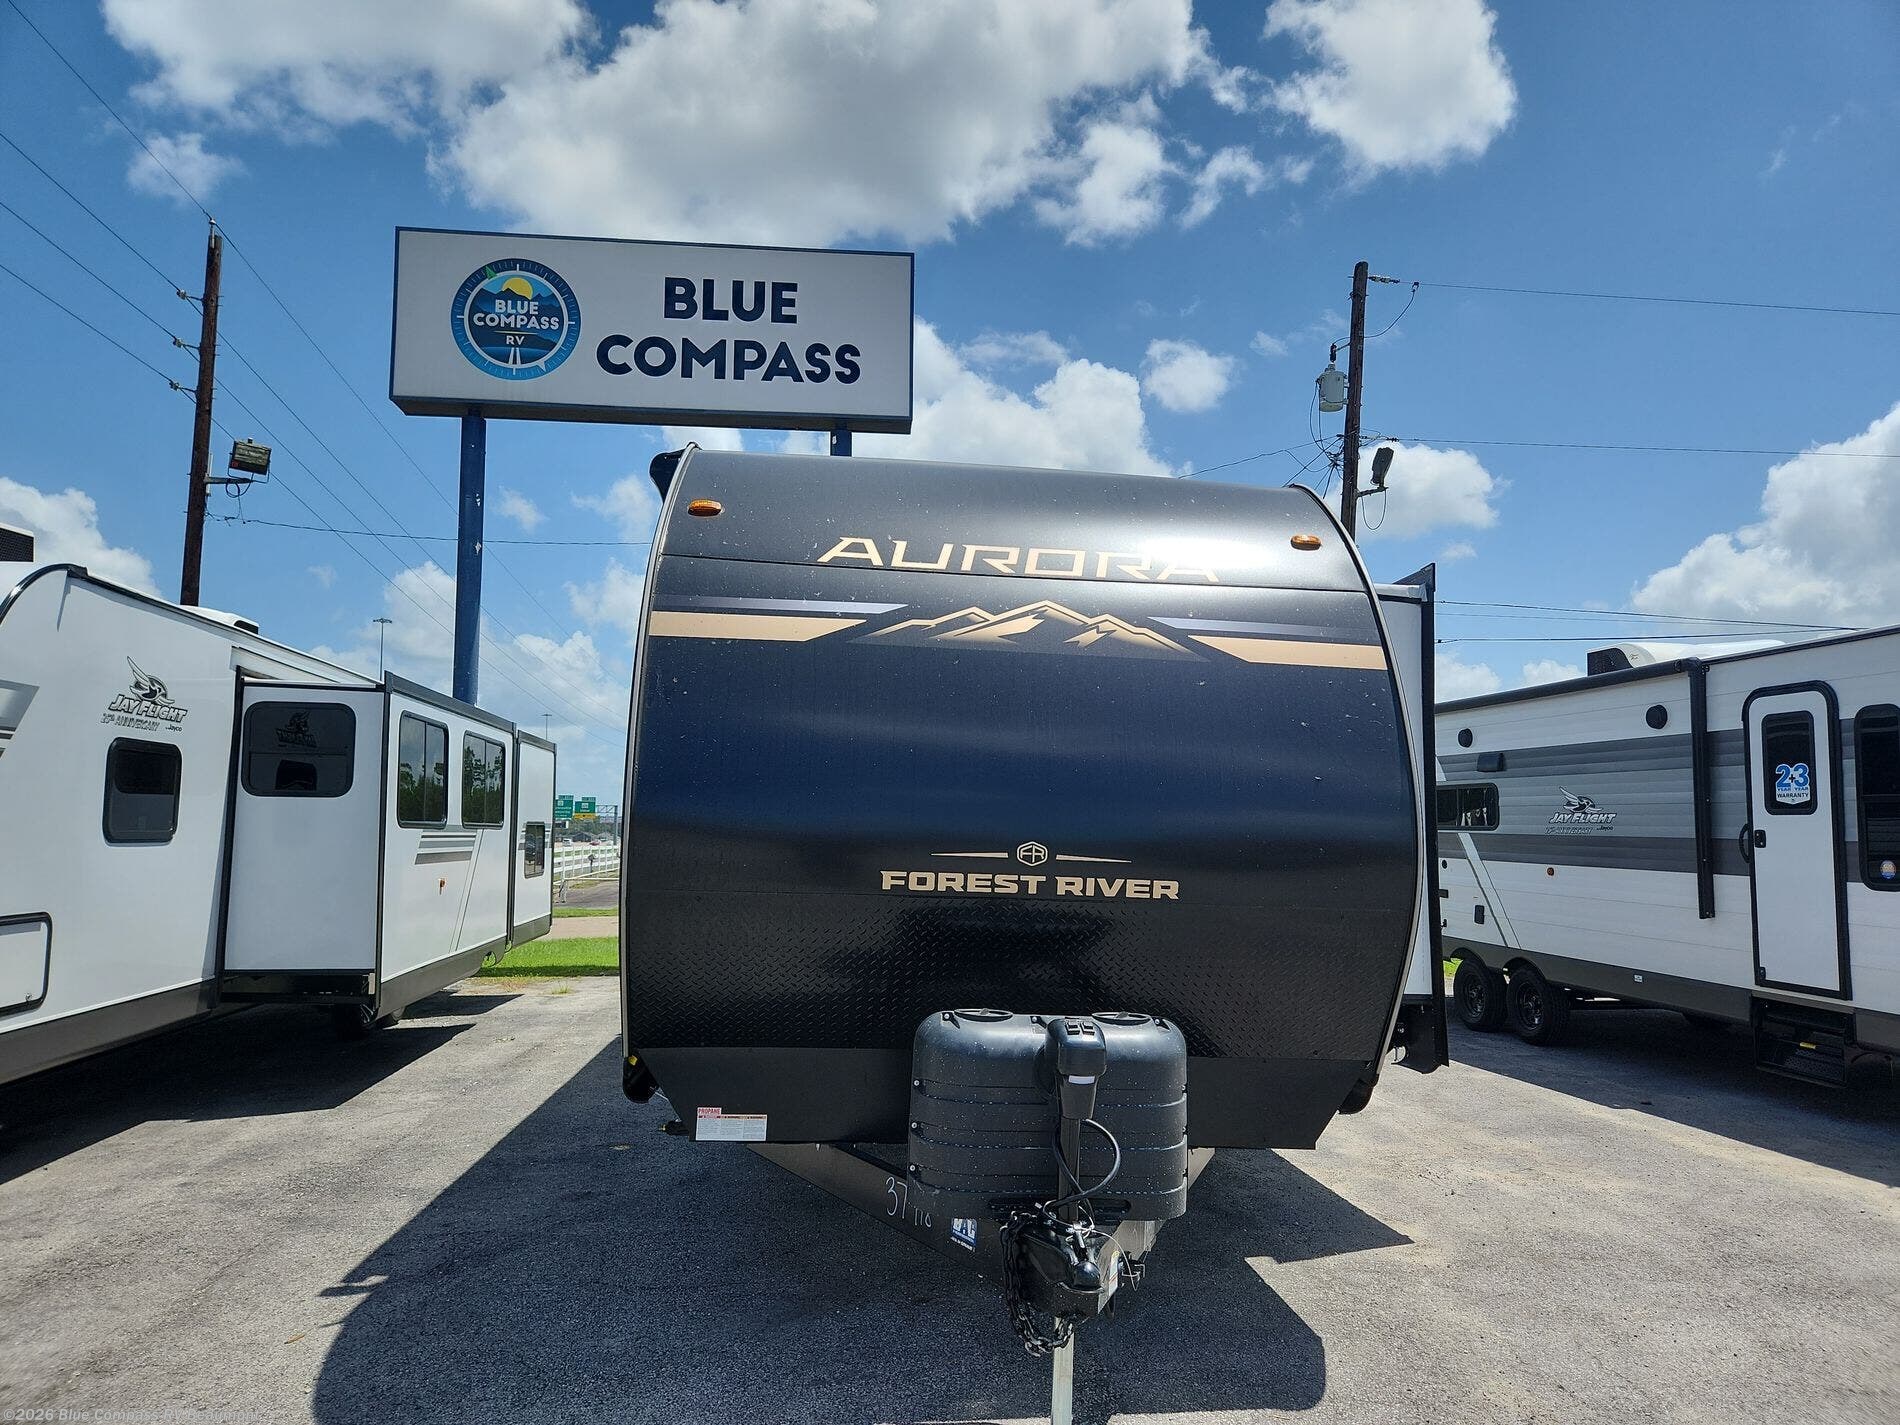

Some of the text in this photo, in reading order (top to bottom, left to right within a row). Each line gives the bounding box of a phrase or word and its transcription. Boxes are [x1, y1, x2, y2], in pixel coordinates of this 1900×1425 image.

[495, 299, 539, 315] BLUE
[664, 277, 798, 324] BLUE
[473, 313, 559, 330] COMPASS
[506, 335, 525, 345] RV
[596, 334, 861, 384] COMPASS
[816, 537, 1221, 582] AURORA
[108, 694, 140, 714] JAY
[136, 699, 188, 723] FLIGHT
[1549, 812, 1617, 823] JAY FLIGHT
[880, 870, 1179, 900] FOREST RIVER
